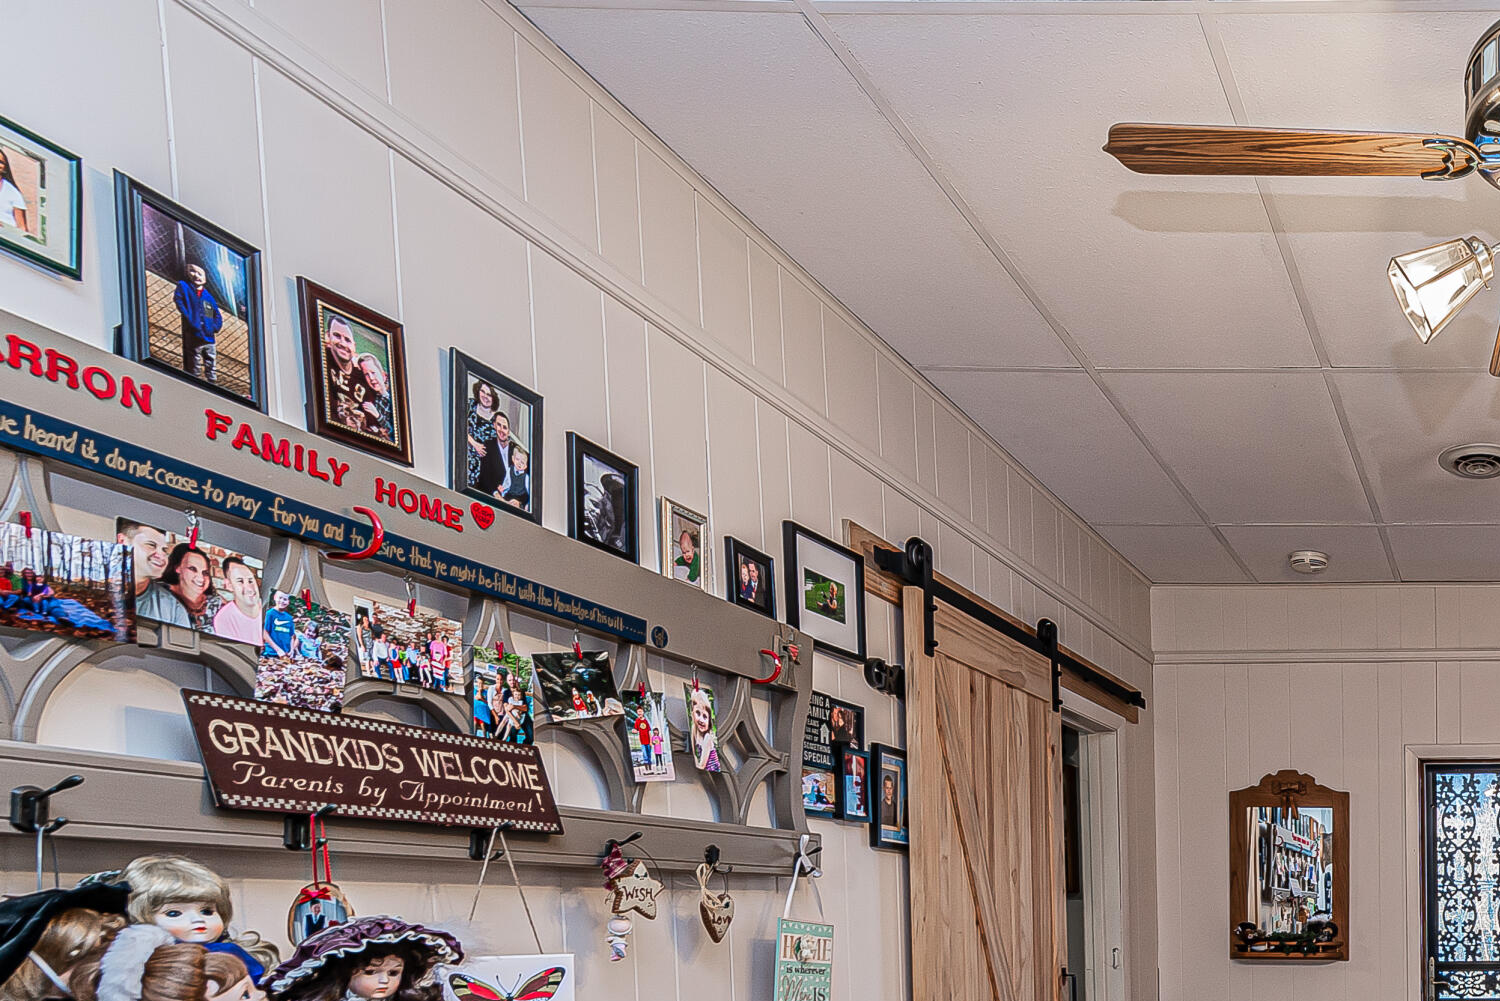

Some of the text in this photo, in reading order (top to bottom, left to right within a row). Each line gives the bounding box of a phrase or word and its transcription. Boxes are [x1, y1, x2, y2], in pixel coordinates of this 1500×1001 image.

[0, 334, 464, 533] RRON FAMILY HOME
[23, 414, 78, 453] heard
[154, 468, 200, 495] cease
[201, 479, 224, 502] to
[226, 491, 262, 520] pray
[268, 497, 297, 527] for
[323, 522, 345, 542] and
[349, 527, 365, 549] to
[367, 534, 406, 562] sire
[409, 545, 433, 570] that
[433, 558, 448, 578] ye
[808, 705, 831, 721] AMILY
[207, 717, 544, 792] GRANDKIDS WELCOME
[803, 750, 832, 766] SPECIAL
[231, 760, 546, 815] Parents by Appointment!
[622, 885, 656, 902] WISH
[786, 963, 826, 976] is wherever
